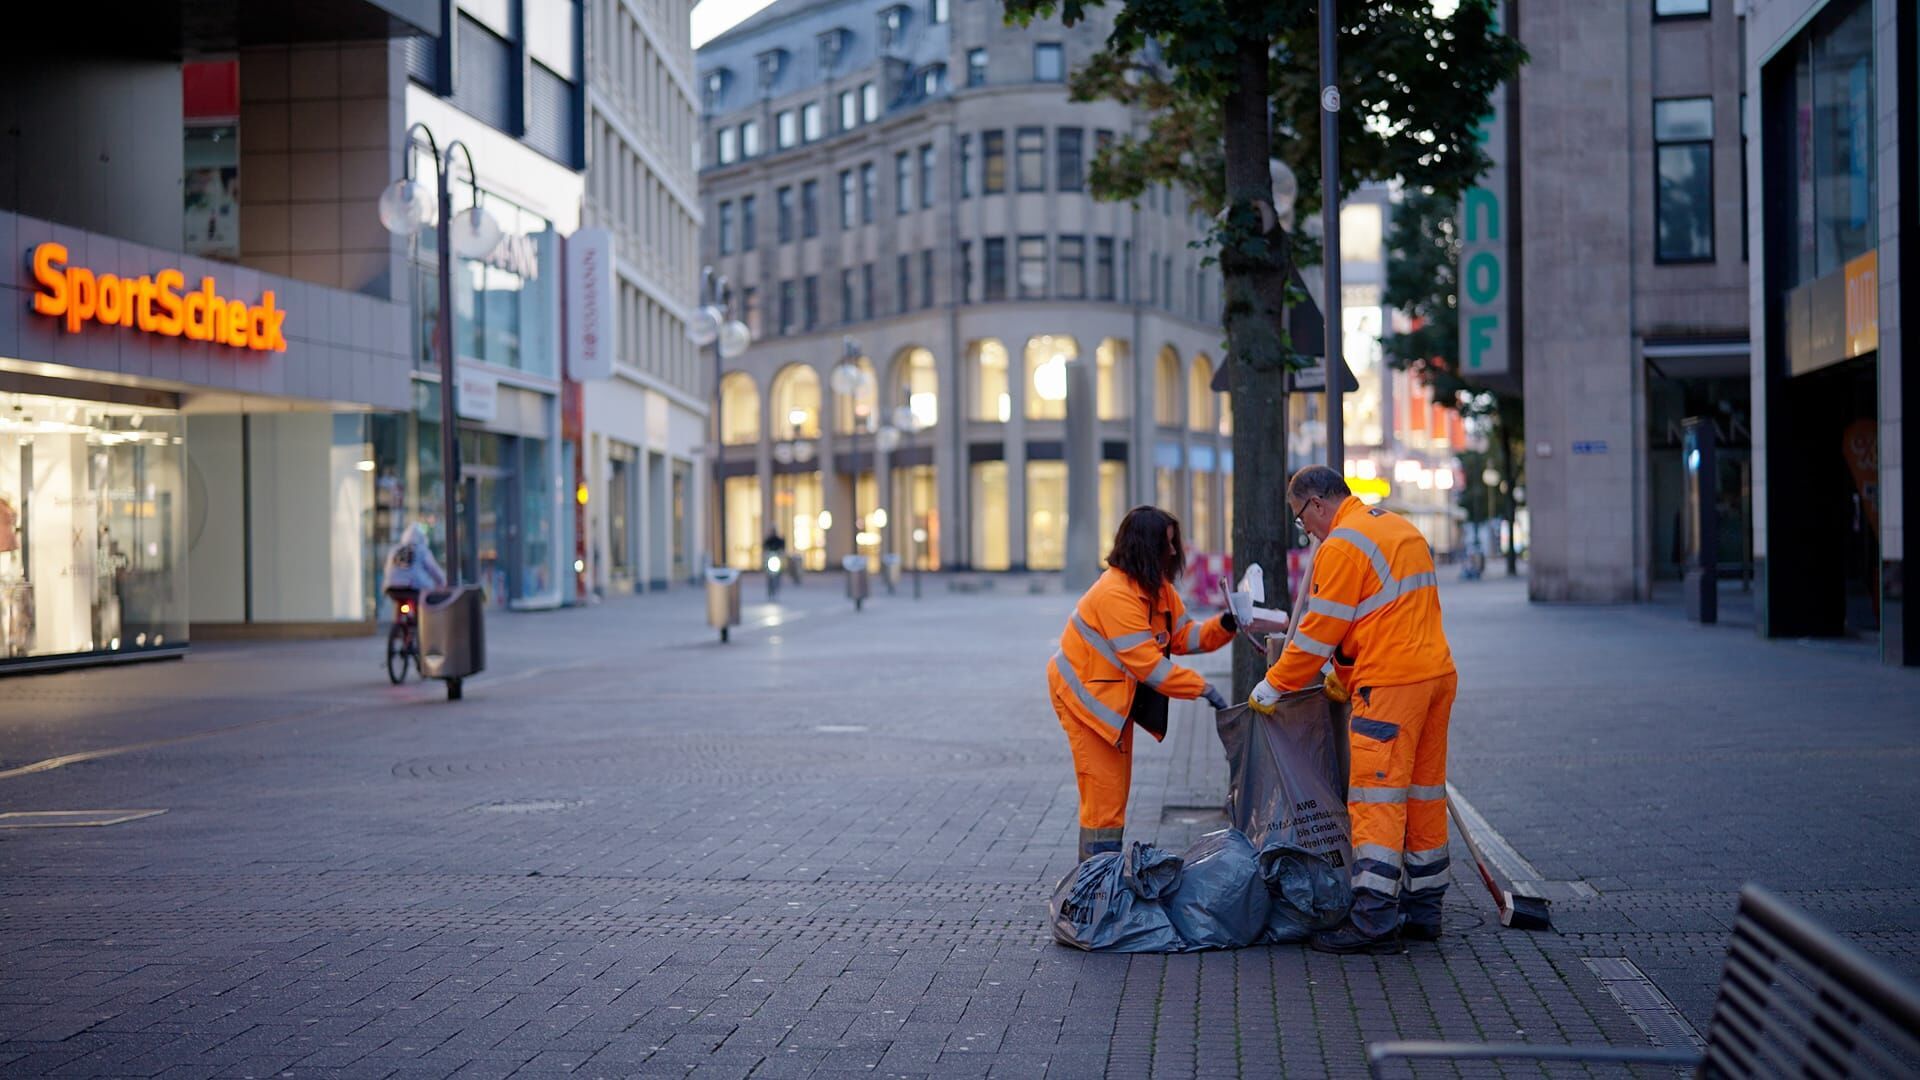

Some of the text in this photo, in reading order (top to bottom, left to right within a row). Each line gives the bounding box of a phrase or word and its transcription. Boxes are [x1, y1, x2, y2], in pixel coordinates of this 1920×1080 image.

[32, 242, 288, 352] SportScheck
[1296, 799, 1318, 812] AWB
[1311, 821, 1338, 834] GmbH
